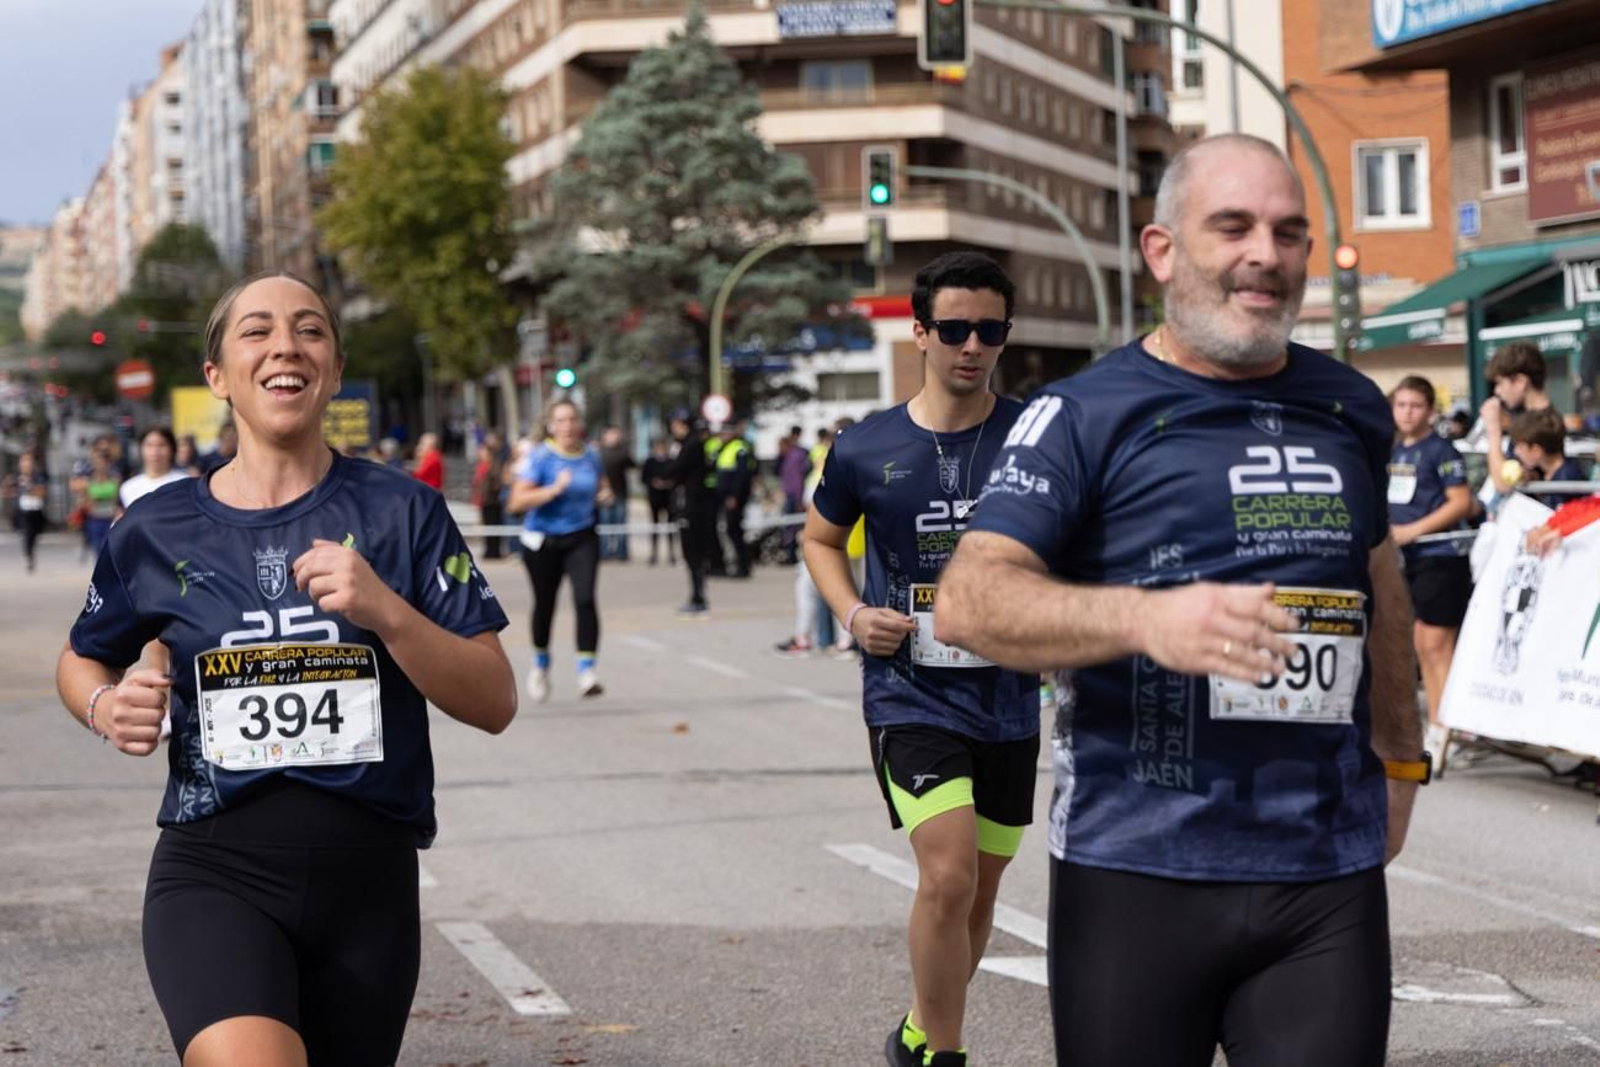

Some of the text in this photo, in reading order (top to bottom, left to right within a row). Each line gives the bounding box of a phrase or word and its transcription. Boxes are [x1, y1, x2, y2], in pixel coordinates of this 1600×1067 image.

[1228, 445, 1344, 494] 25
[1232, 495, 1348, 513] CARRERA
[1235, 512, 1351, 531] POPULAR
[916, 532, 961, 542] CARR
[916, 589, 935, 603] XX
[221, 606, 340, 648] 25
[245, 648, 367, 662] CARRERA POPULAR
[205, 653, 241, 677] XXV
[245, 656, 369, 673] y gran caminata
[244, 676, 258, 686] LA
[286, 673, 300, 683] LA
[238, 689, 344, 741] 394
